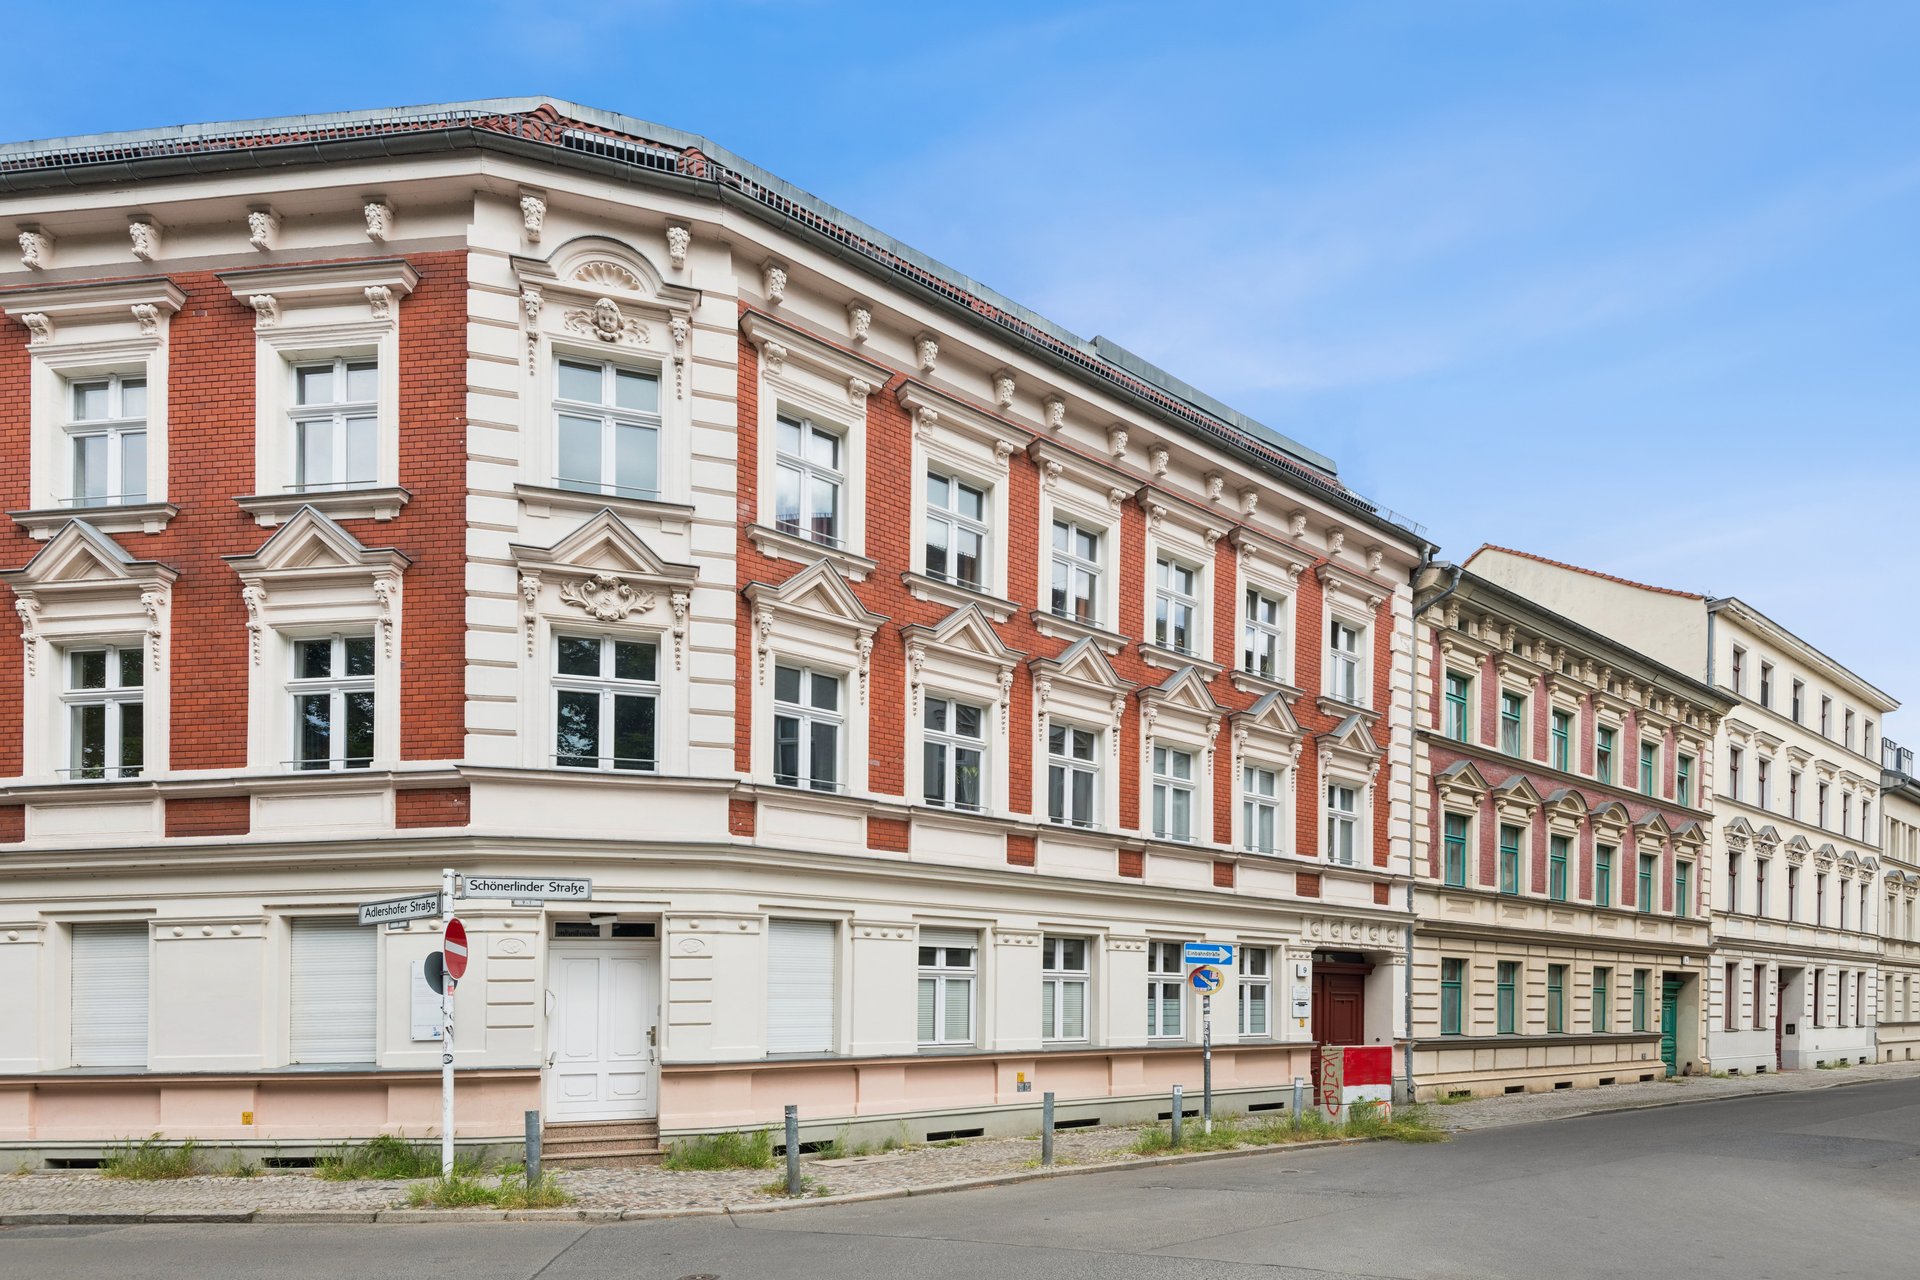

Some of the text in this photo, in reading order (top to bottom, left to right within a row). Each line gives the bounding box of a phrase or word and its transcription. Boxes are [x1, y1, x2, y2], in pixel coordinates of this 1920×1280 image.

[469, 879, 585, 896] Schönerlinder Straße
[364, 899, 436, 919] Adlershofer Straße
